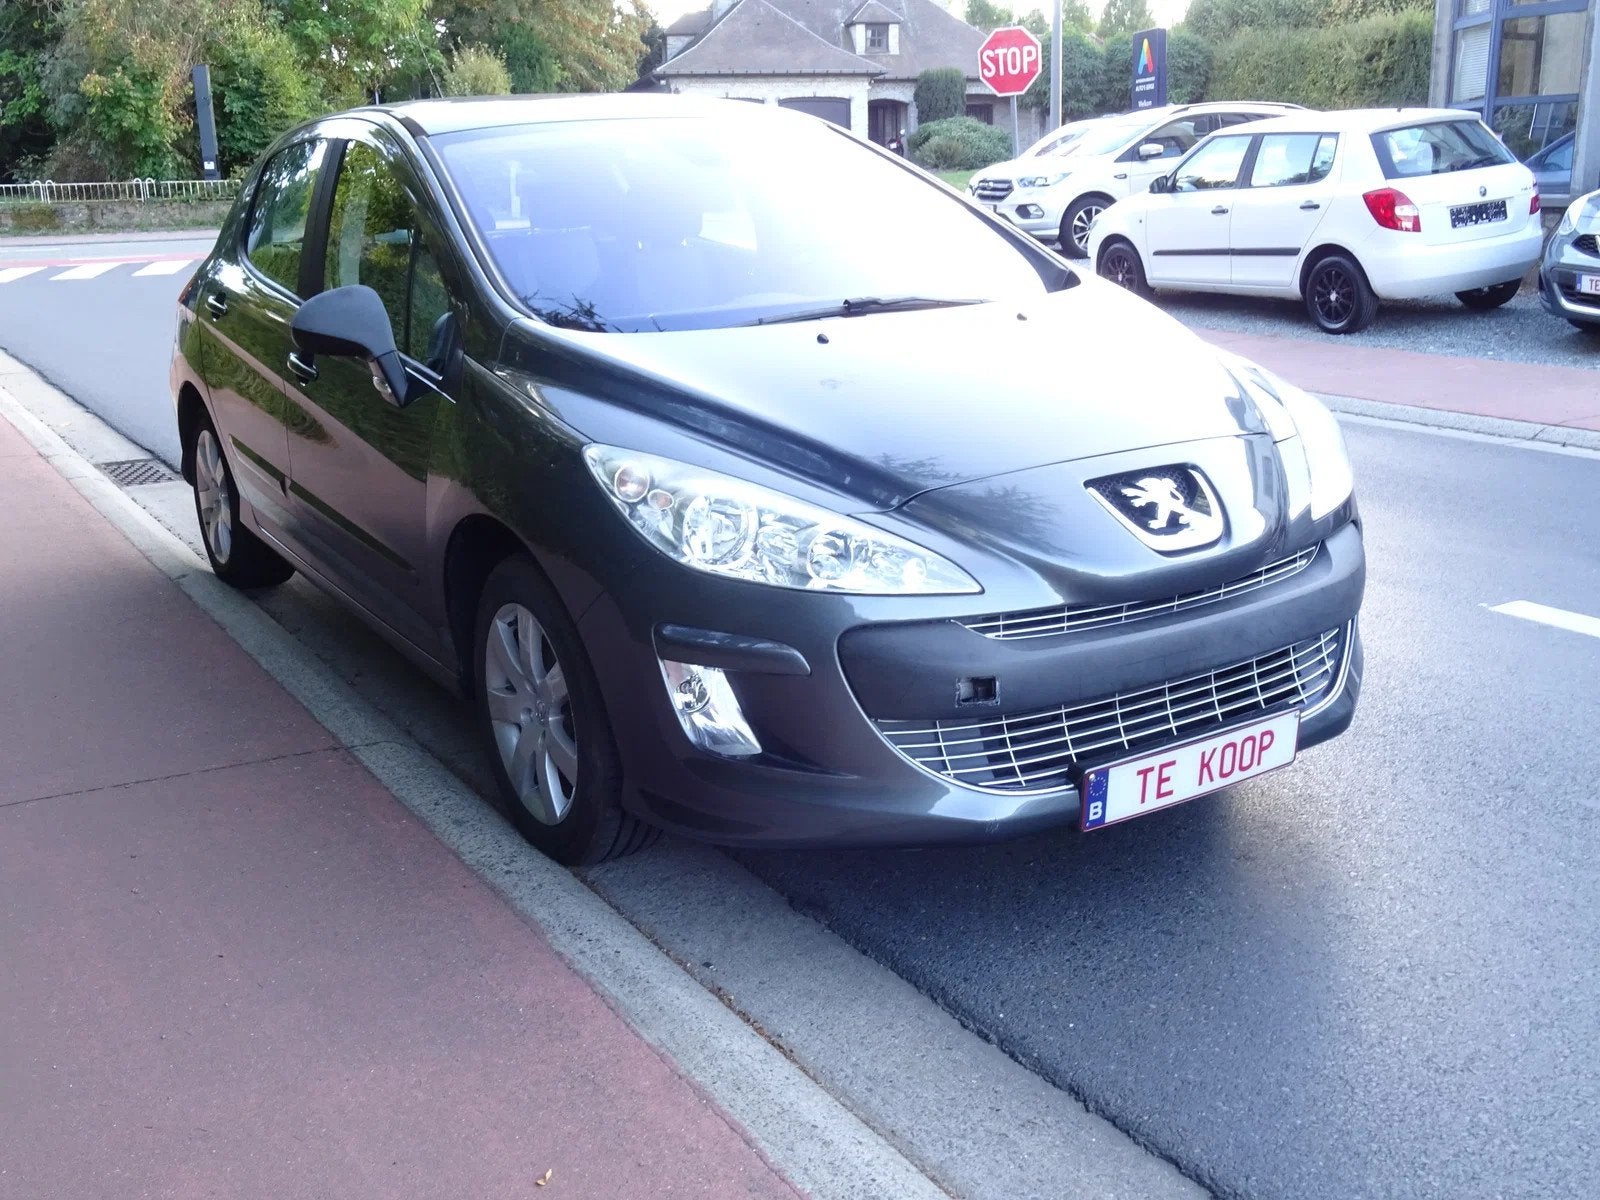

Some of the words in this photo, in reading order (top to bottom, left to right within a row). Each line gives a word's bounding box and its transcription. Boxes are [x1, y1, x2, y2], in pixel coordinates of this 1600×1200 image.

[982, 45, 1036, 78] STOP
[1136, 760, 1176, 804] TE
[1198, 729, 1274, 786] KOOP
[1089, 801, 1102, 821] B
